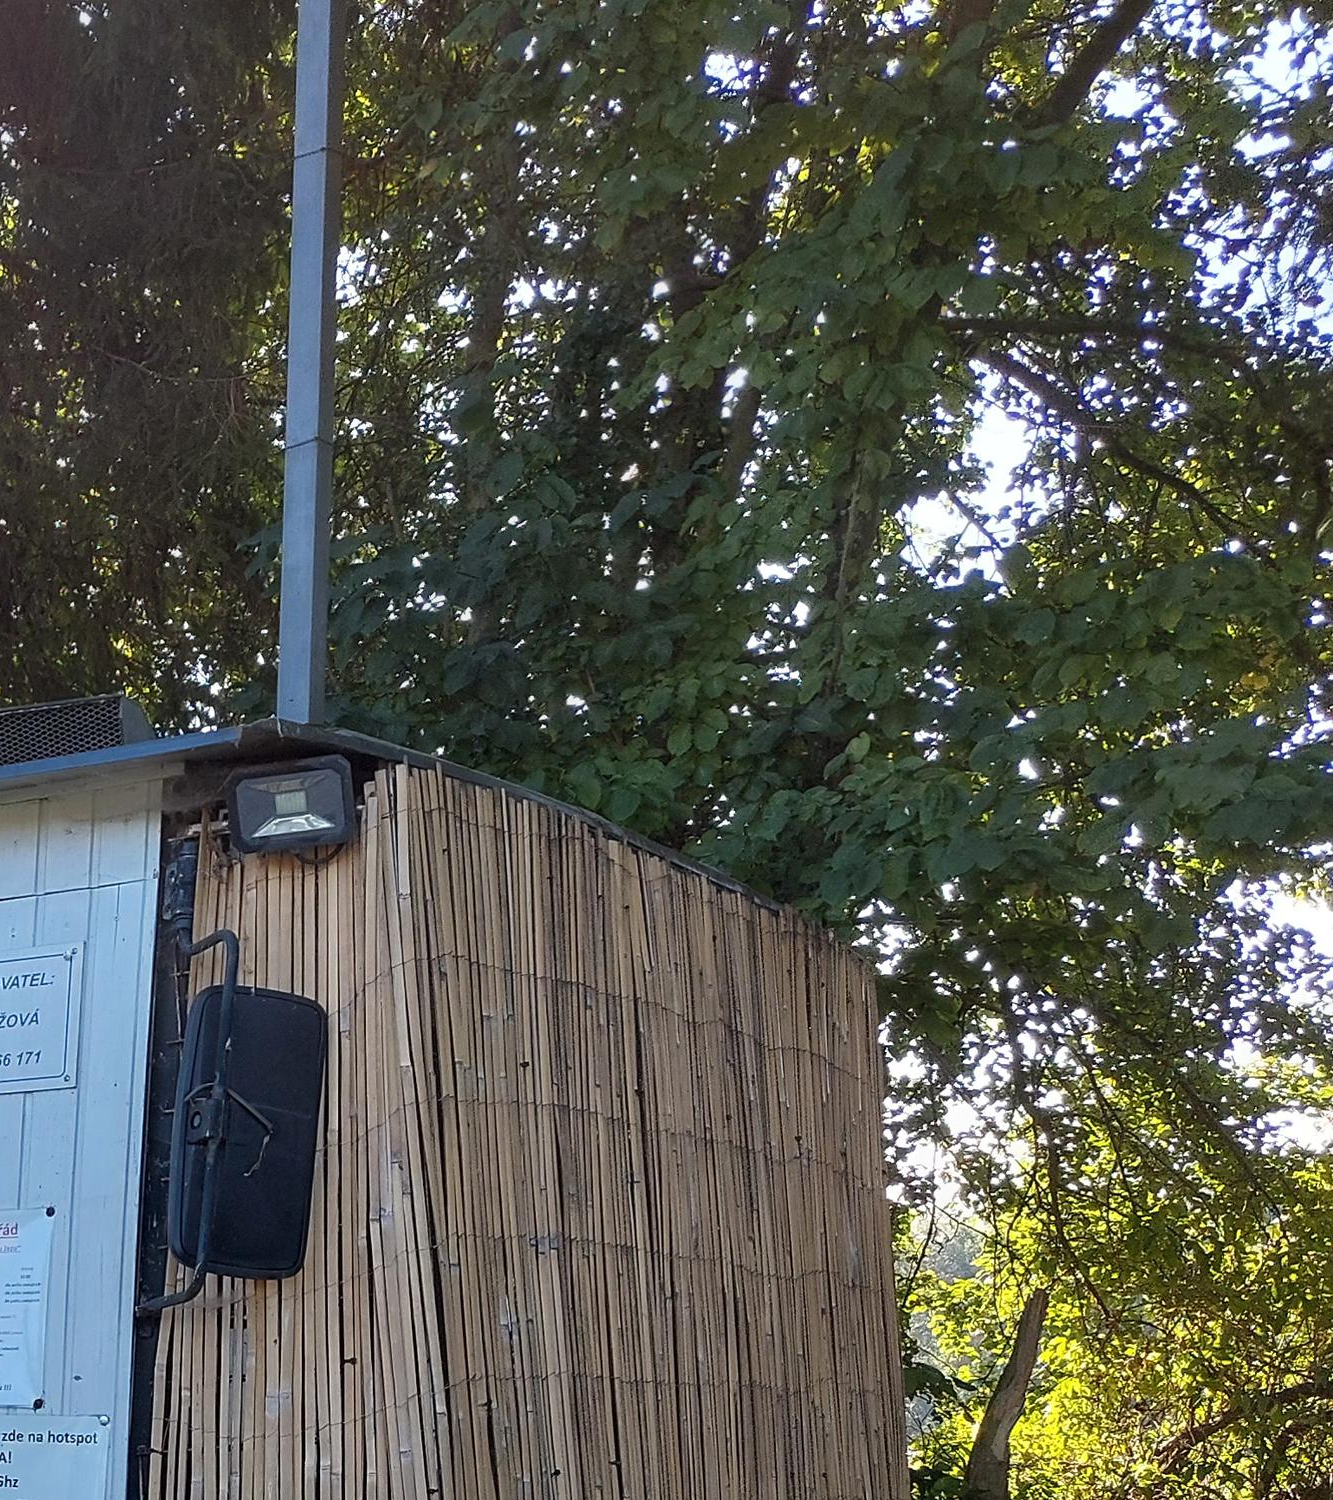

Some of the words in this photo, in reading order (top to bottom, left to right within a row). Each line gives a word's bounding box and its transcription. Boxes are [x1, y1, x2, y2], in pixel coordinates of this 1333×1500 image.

[16, 1050, 42, 1067] 171
[1, 1429, 24, 1443] zde
[28, 1432, 44, 1443] na
[47, 1430, 98, 1446] hotspot
